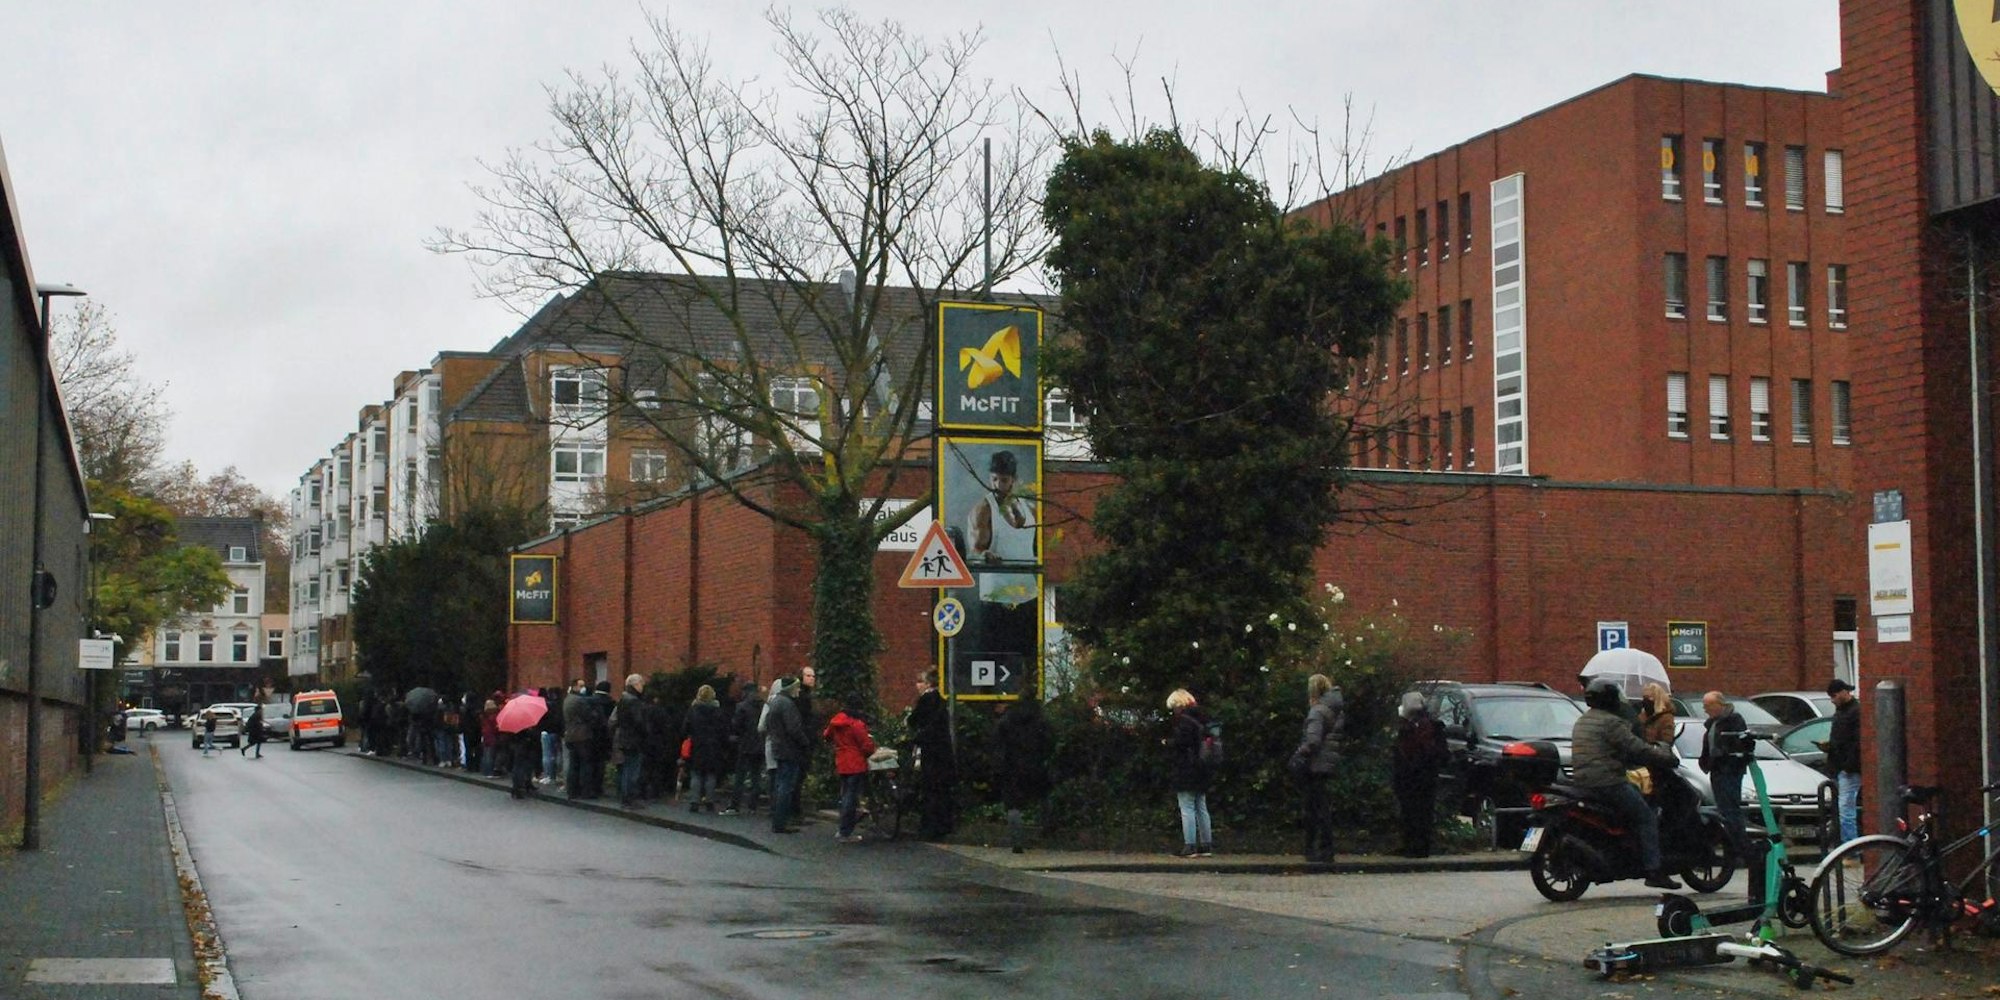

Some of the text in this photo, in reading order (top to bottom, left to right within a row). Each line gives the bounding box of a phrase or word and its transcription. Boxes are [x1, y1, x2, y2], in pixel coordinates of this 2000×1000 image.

[960, 394, 1020, 413] McFIT
[516, 589, 551, 600] McFIT
[1679, 628, 1702, 636] McFIT
[1606, 630, 1620, 650] P
[978, 667, 988, 680] P
